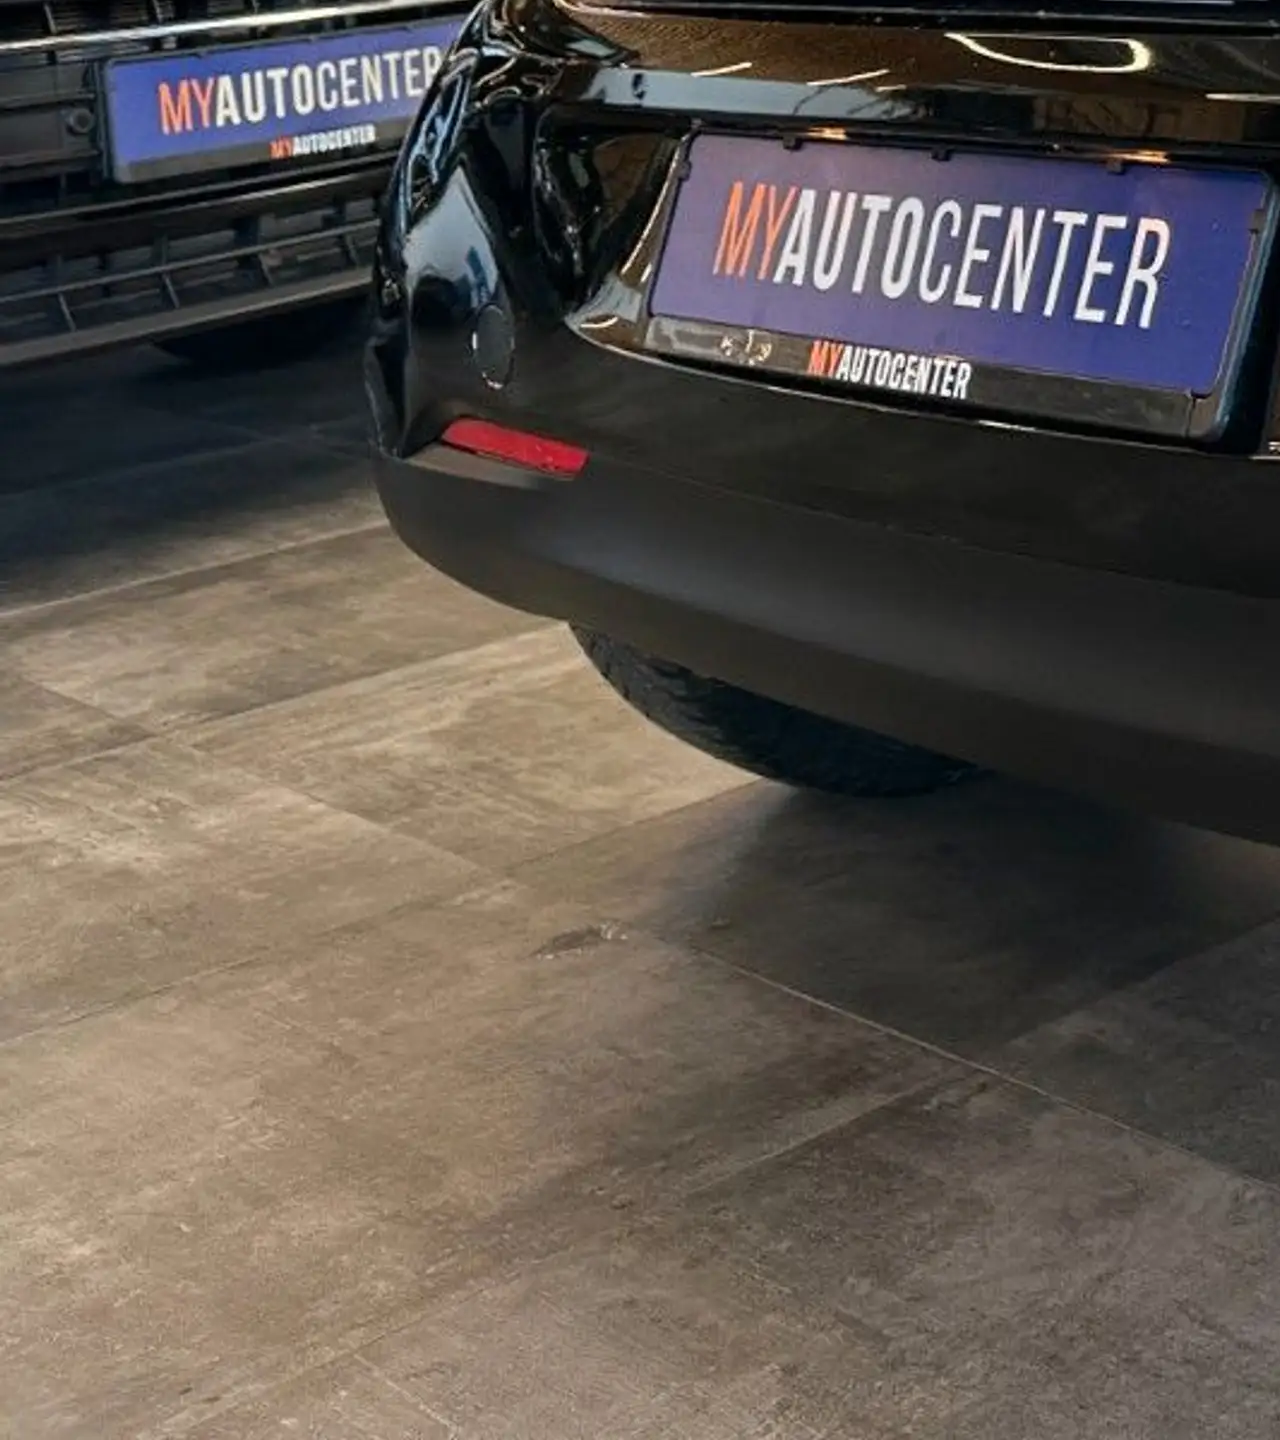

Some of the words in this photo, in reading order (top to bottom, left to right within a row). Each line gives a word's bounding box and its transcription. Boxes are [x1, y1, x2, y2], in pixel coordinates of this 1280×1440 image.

[270, 123, 375, 160] MYAUTOCENTER
[713, 180, 1171, 330] MYAUTOCENTER
[807, 340, 971, 400] MYAUTOCENTER
